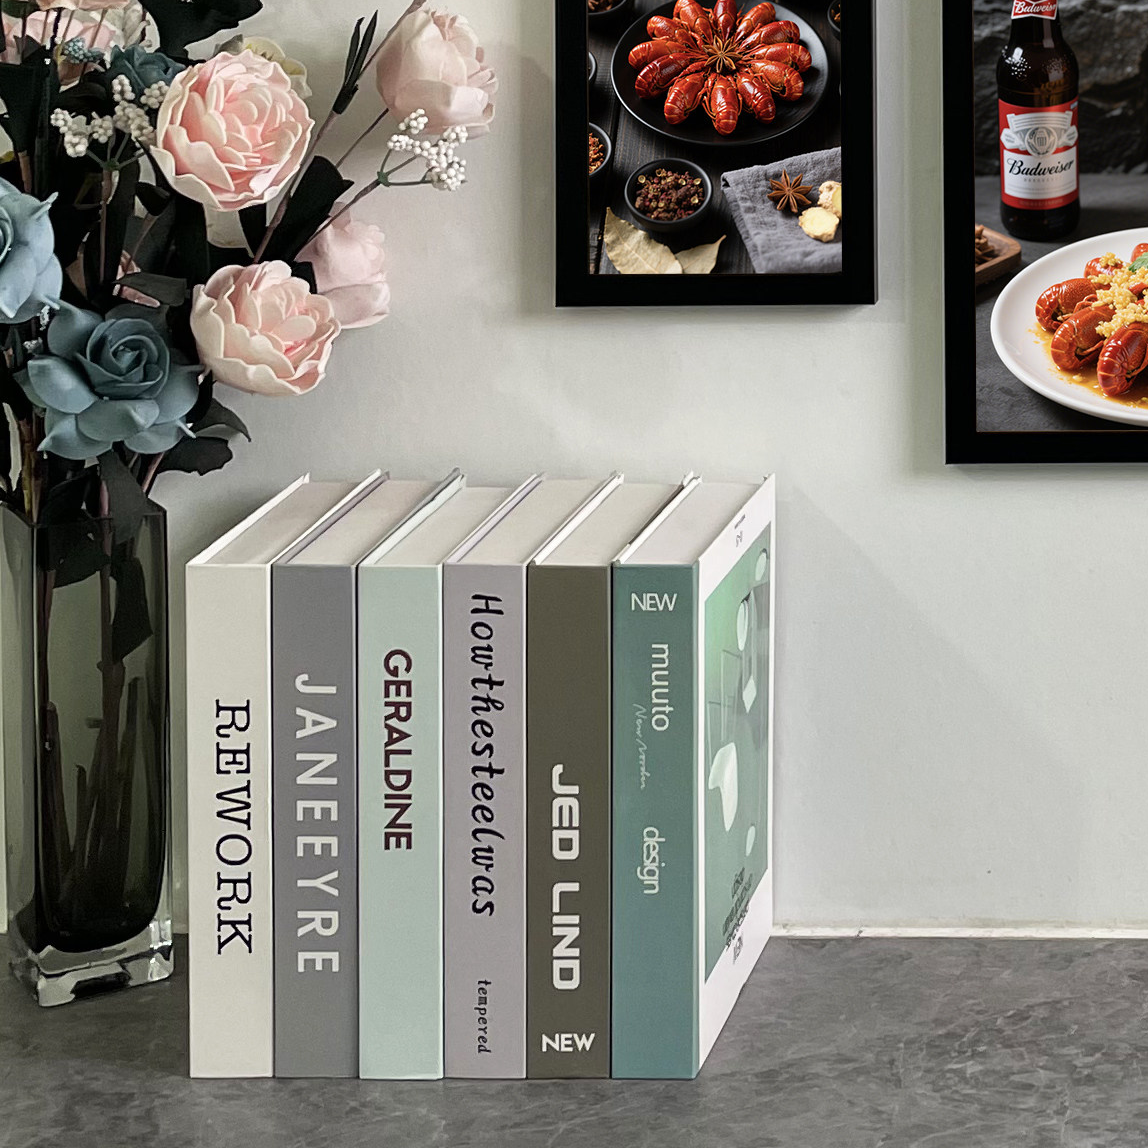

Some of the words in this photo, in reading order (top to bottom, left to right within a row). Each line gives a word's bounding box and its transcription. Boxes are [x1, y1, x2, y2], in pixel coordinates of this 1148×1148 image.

[1006, 157, 1075, 178] Budweiser
[632, 592, 678, 612] NEW
[651, 643, 674, 732] muuto
[383, 648, 413, 851] GERALDINE
[470, 593, 506, 917] Howthesteelwas
[214, 698, 253, 955] REWORK
[295, 673, 340, 973] JANEEYRE
[551, 763, 580, 861] JED
[637, 826, 666, 894] design
[551, 882, 581, 990] LIND
[473, 979, 492, 1054] tempered
[541, 1032, 596, 1053] NEW
